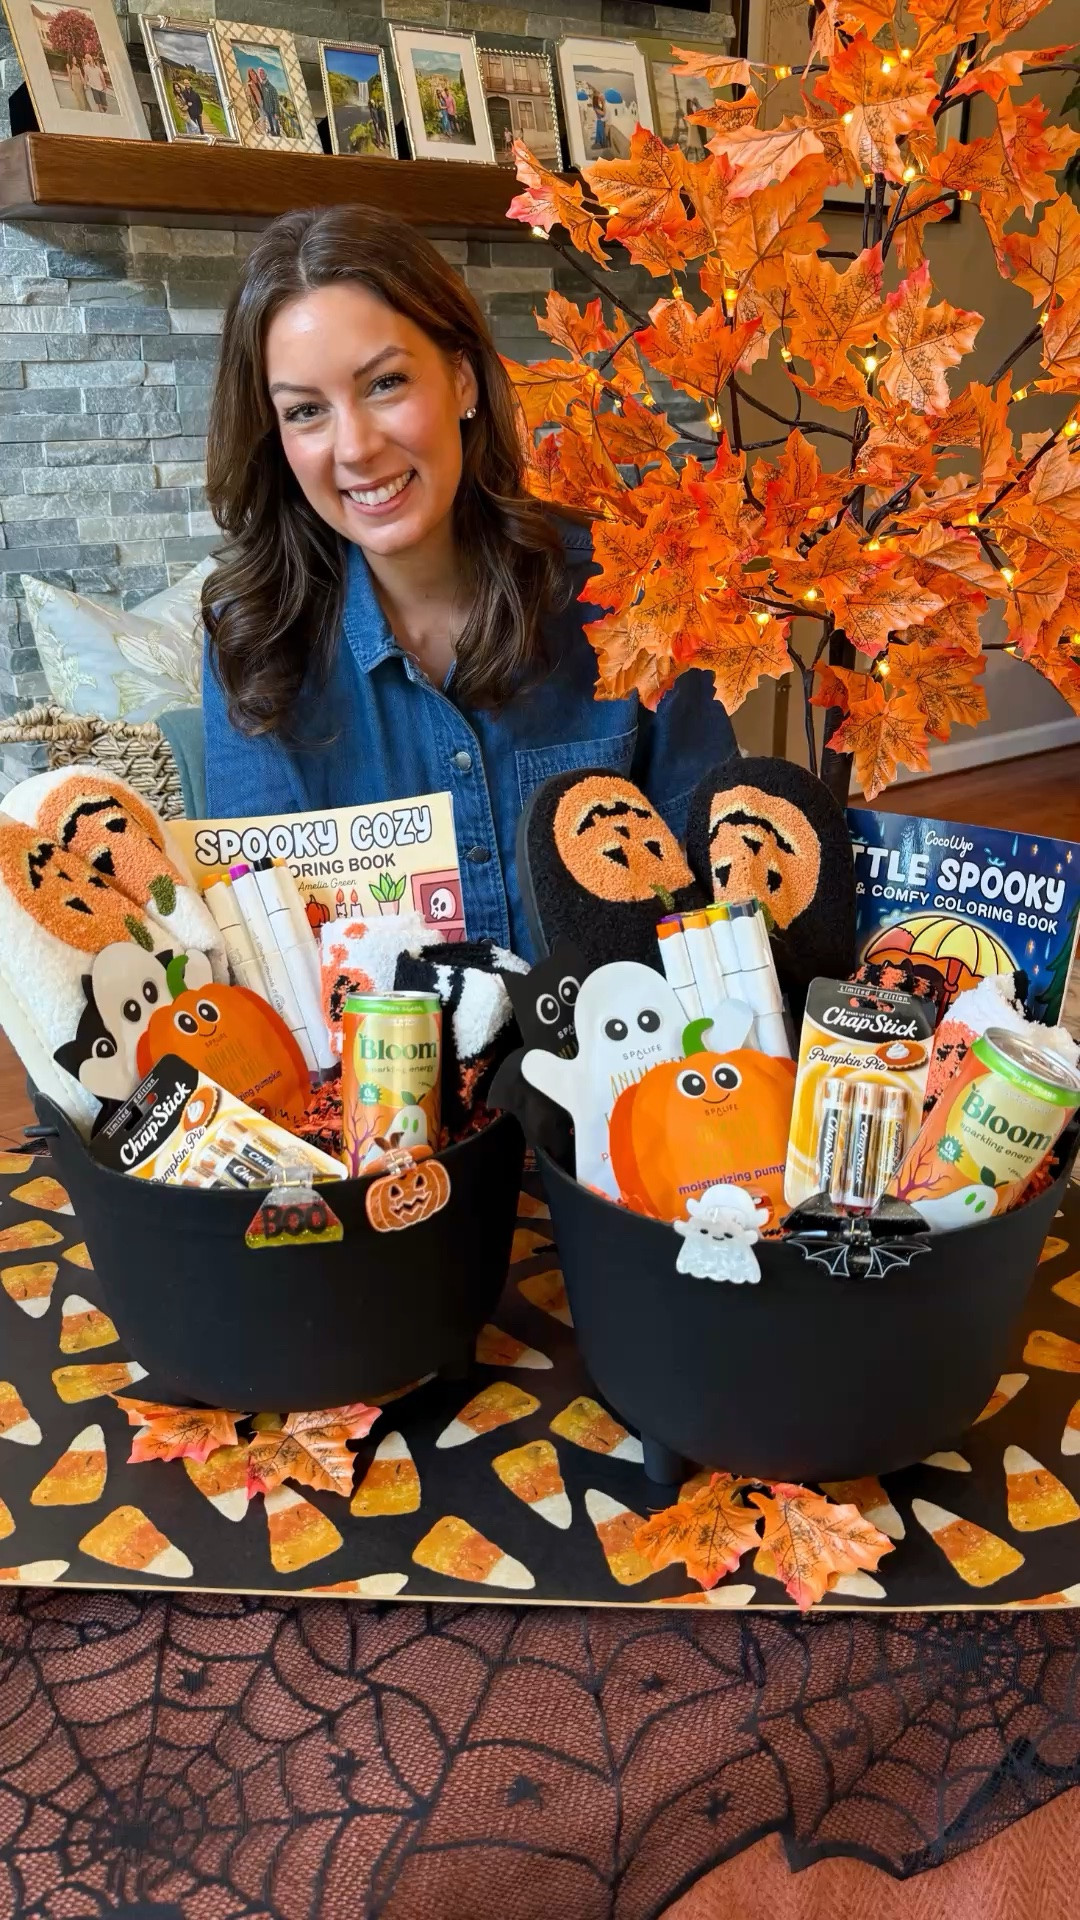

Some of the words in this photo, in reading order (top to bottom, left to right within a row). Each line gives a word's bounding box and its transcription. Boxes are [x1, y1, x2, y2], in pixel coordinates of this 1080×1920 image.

[195, 819, 338, 866] SPOOKY
[350, 805, 432, 851] COZY
[289, 859, 345, 879] ORING
[349, 853, 396, 872] BOOK
[297, 881, 329, 892] Amelia
[330, 877, 357, 889] Green
[937, 857, 1066, 914] SPOOKY
[855, 881, 866, 895] &
[871, 884, 930, 906] COMFY
[933, 895, 1013, 924] COLORING
[1017, 913, 1058, 936] BOOK
[839, 985, 871, 997] Limited
[878, 992, 909, 1003] Edition
[822, 1006, 918, 1038] ChapStick
[359, 1036, 437, 1060] Bloom
[808, 1047, 863, 1068] Pumpkin
[863, 1056, 887, 1071] Pie
[254, 1070, 283, 1092] pumpkin
[106, 1108, 130, 1136] Limited
[133, 1078, 156, 1104] Edition
[120, 1081, 191, 1165] ChapStick
[962, 1088, 1051, 1151] Bloom
[186, 1127, 206, 1150] Pie
[961, 1122, 1004, 1153] sparkling
[678, 1171, 752, 1196] moisturizing
[754, 1163, 786, 1180] pump
[261, 1204, 327, 1240] BOO
